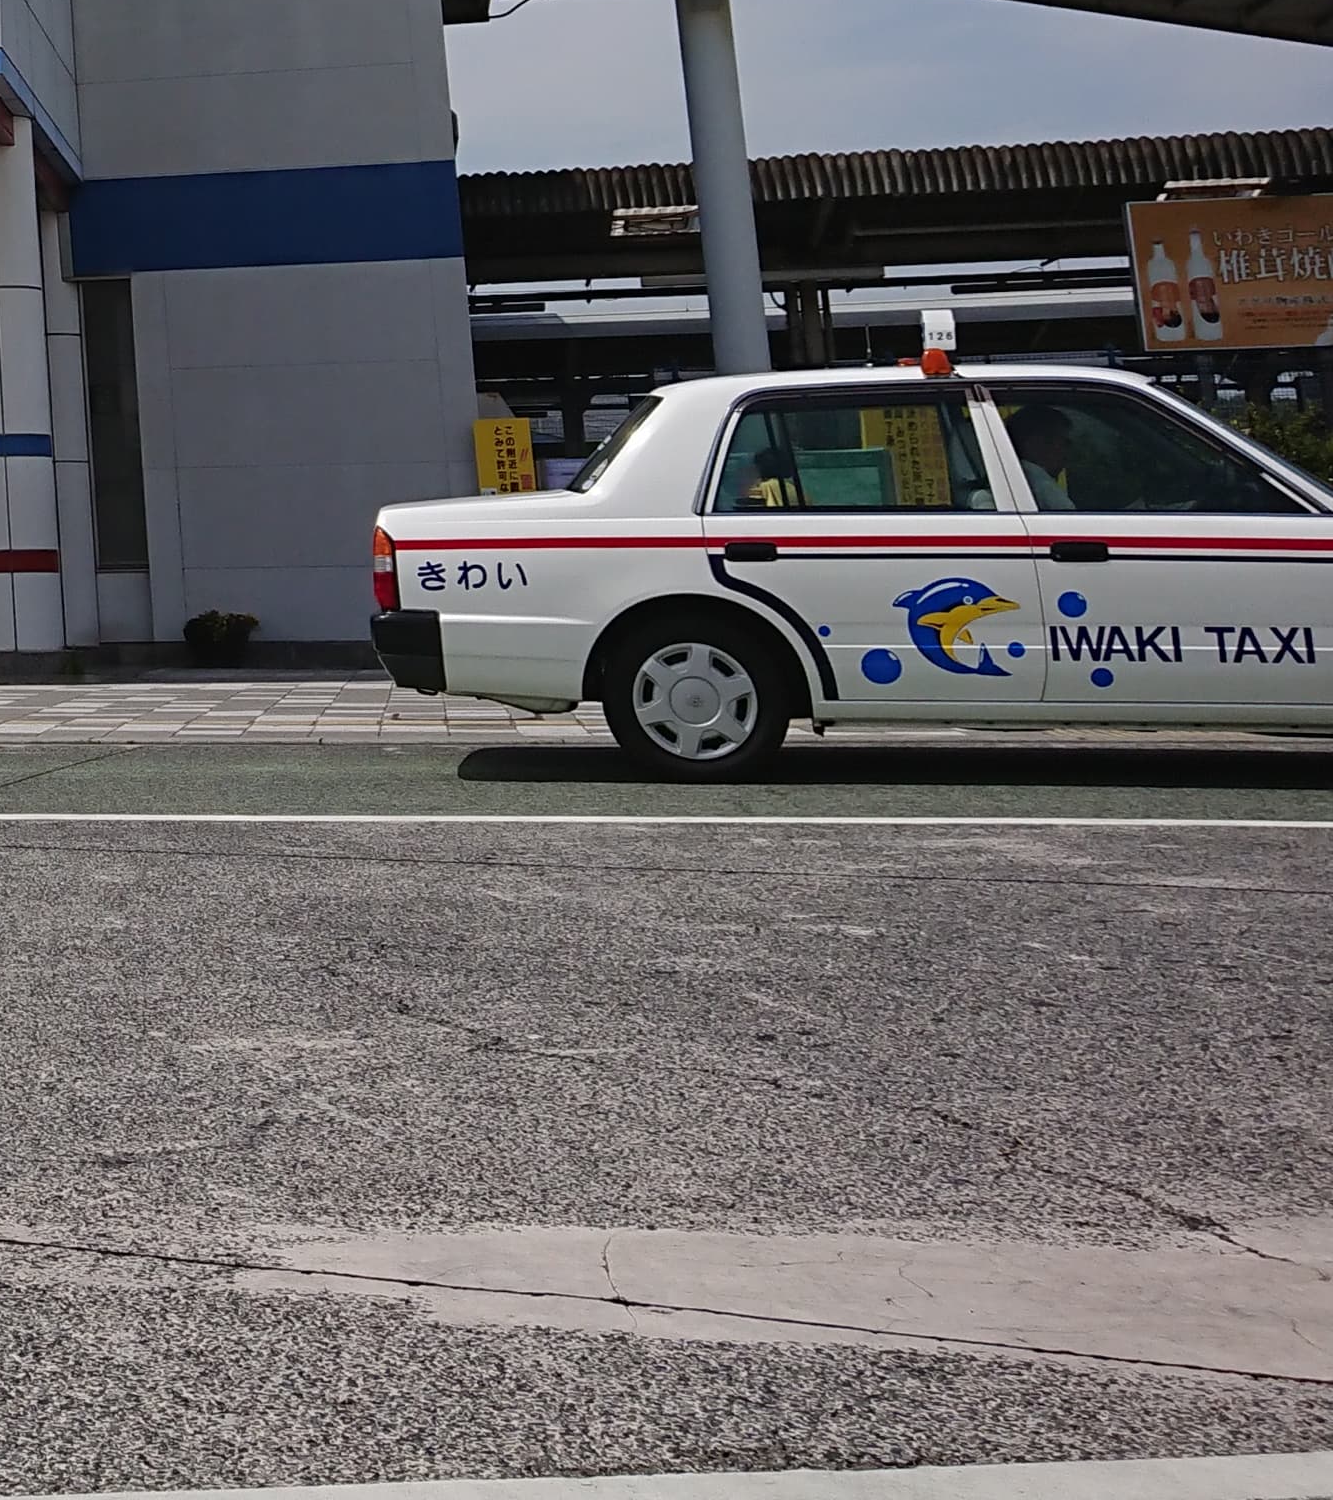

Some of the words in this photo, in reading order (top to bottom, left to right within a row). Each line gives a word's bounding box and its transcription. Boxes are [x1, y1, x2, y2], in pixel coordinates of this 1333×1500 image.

[1219, 247, 1333, 283] 椎茸焼
[928, 331, 953, 341] 126
[417, 560, 528, 591] きわい
[1049, 626, 1183, 663] IWAKI
[1204, 627, 1316, 664] TAXI
